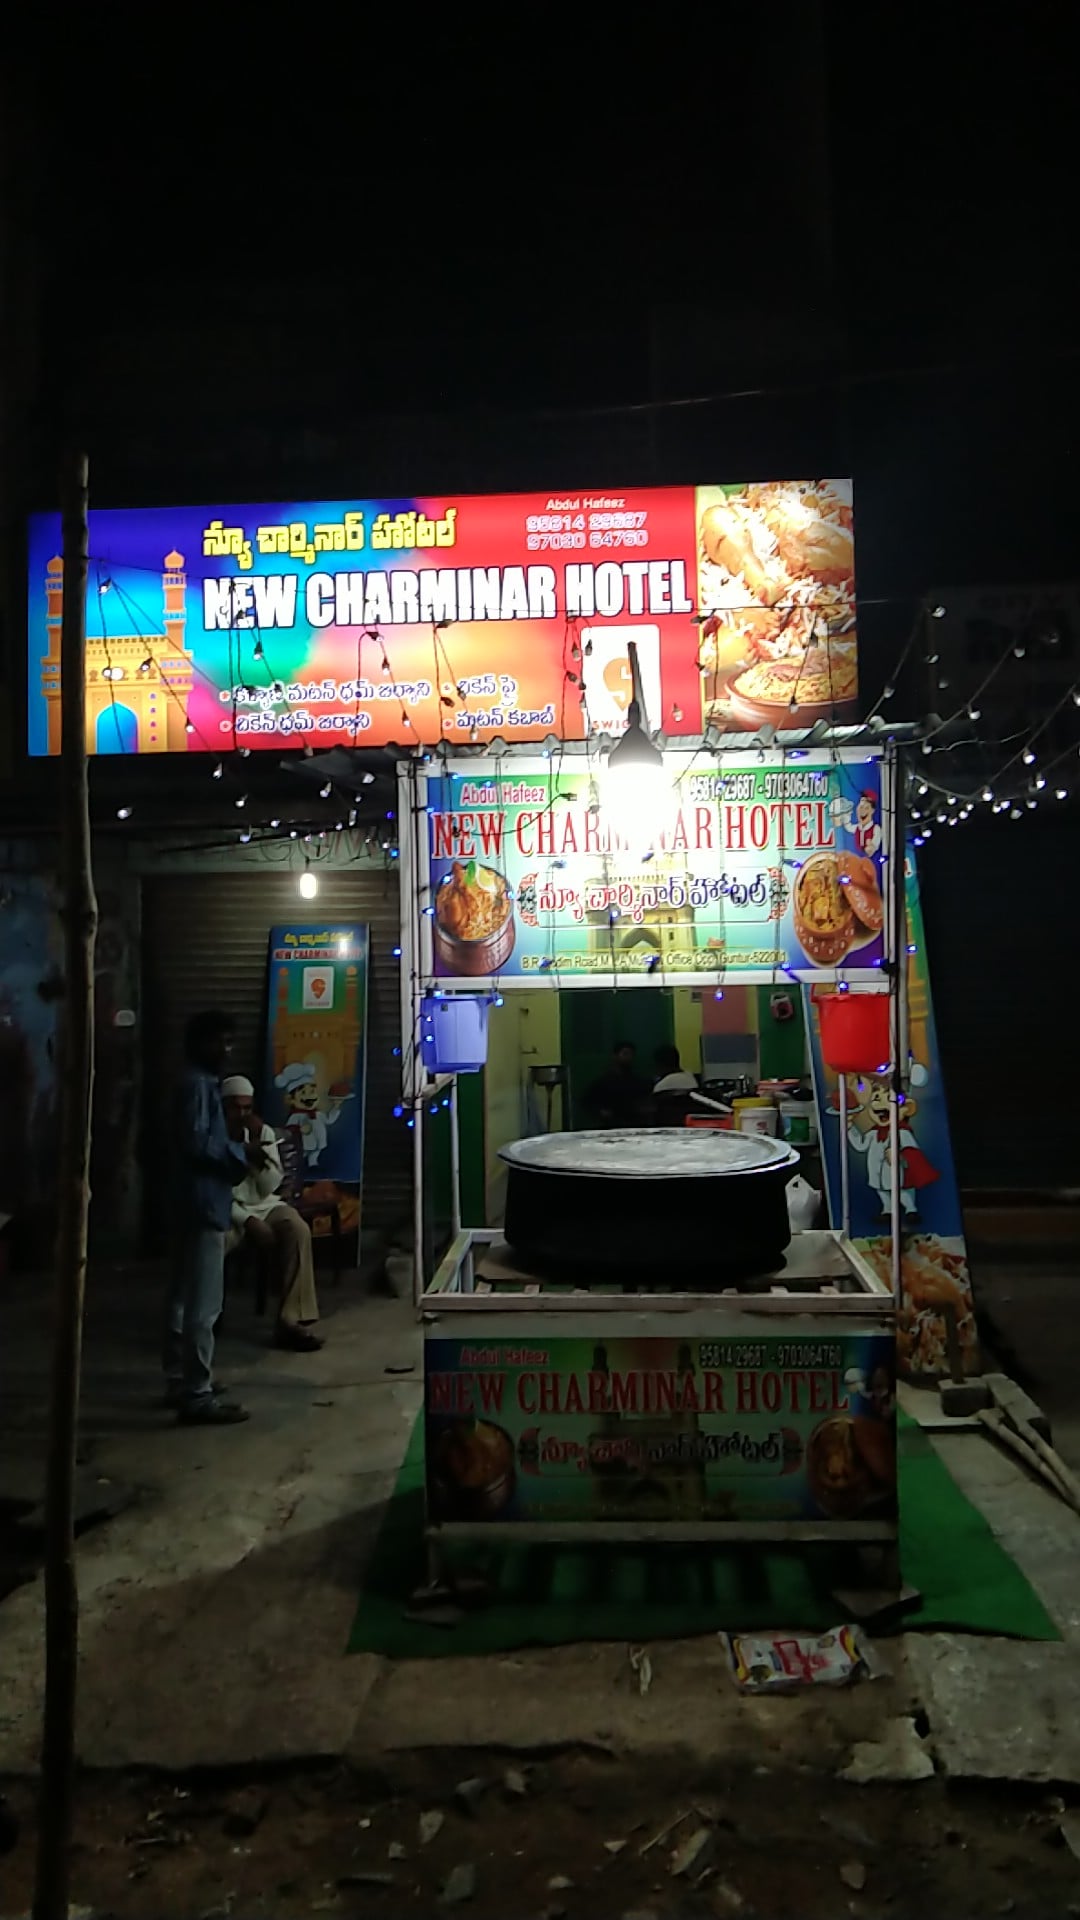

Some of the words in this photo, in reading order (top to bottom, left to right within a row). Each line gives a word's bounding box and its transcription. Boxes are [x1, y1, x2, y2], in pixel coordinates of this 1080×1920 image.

[545, 499, 580, 511] Abdul
[203, 574, 298, 631] NEW
[305, 564, 557, 629] CHARMINAR
[565, 558, 694, 617] HOTEL
[503, 781, 546, 803] Hafeez
[432, 812, 504, 858] NEW
[516, 806, 713, 858] CHARAR
[725, 801, 836, 850] HOTEL
[429, 1371, 506, 1414] NEW
[517, 1370, 727, 1415] CHARMINAR
[735, 1369, 849, 1414] HOTEL
